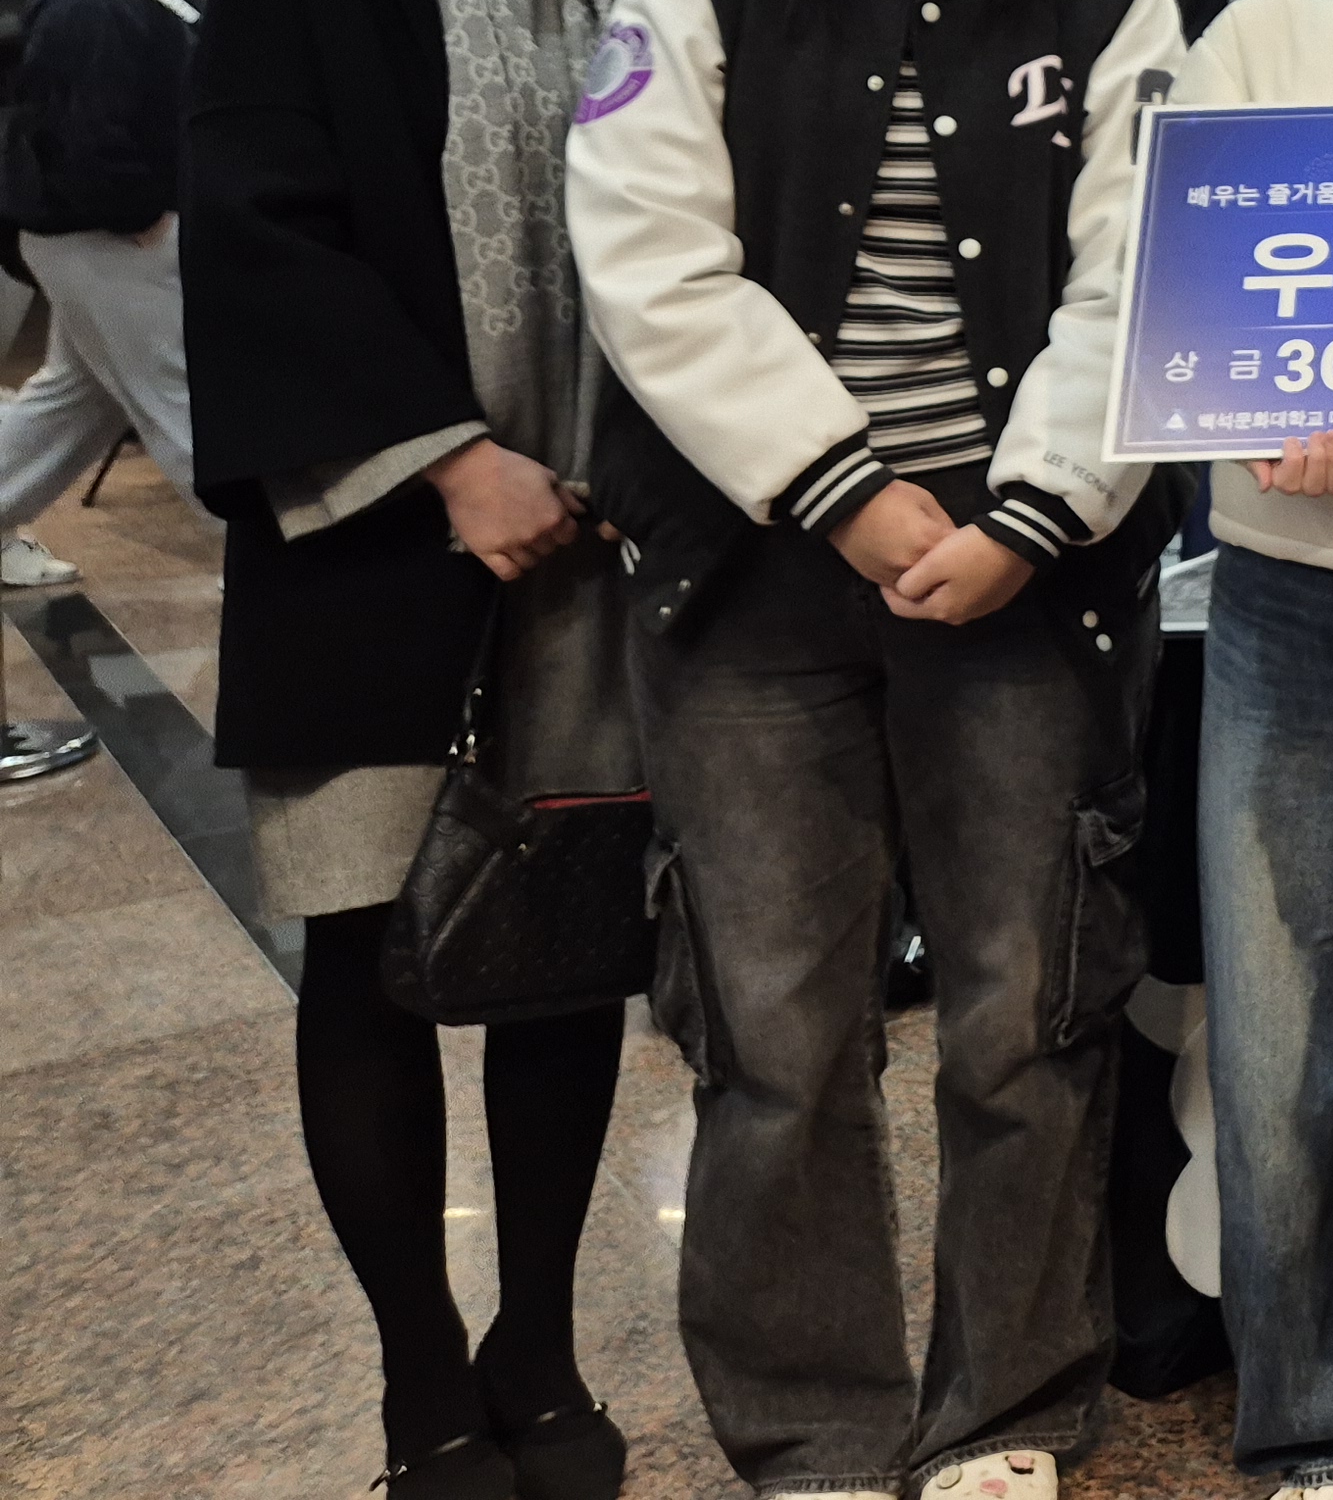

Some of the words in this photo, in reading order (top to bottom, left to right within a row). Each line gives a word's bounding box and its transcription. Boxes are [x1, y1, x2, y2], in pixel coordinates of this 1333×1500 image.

[1187, 183, 1260, 208] 배우는
[1164, 350, 1198, 383] 상
[1228, 349, 1262, 381] 금
[1197, 409, 1324, 431] 백석문화대학교
